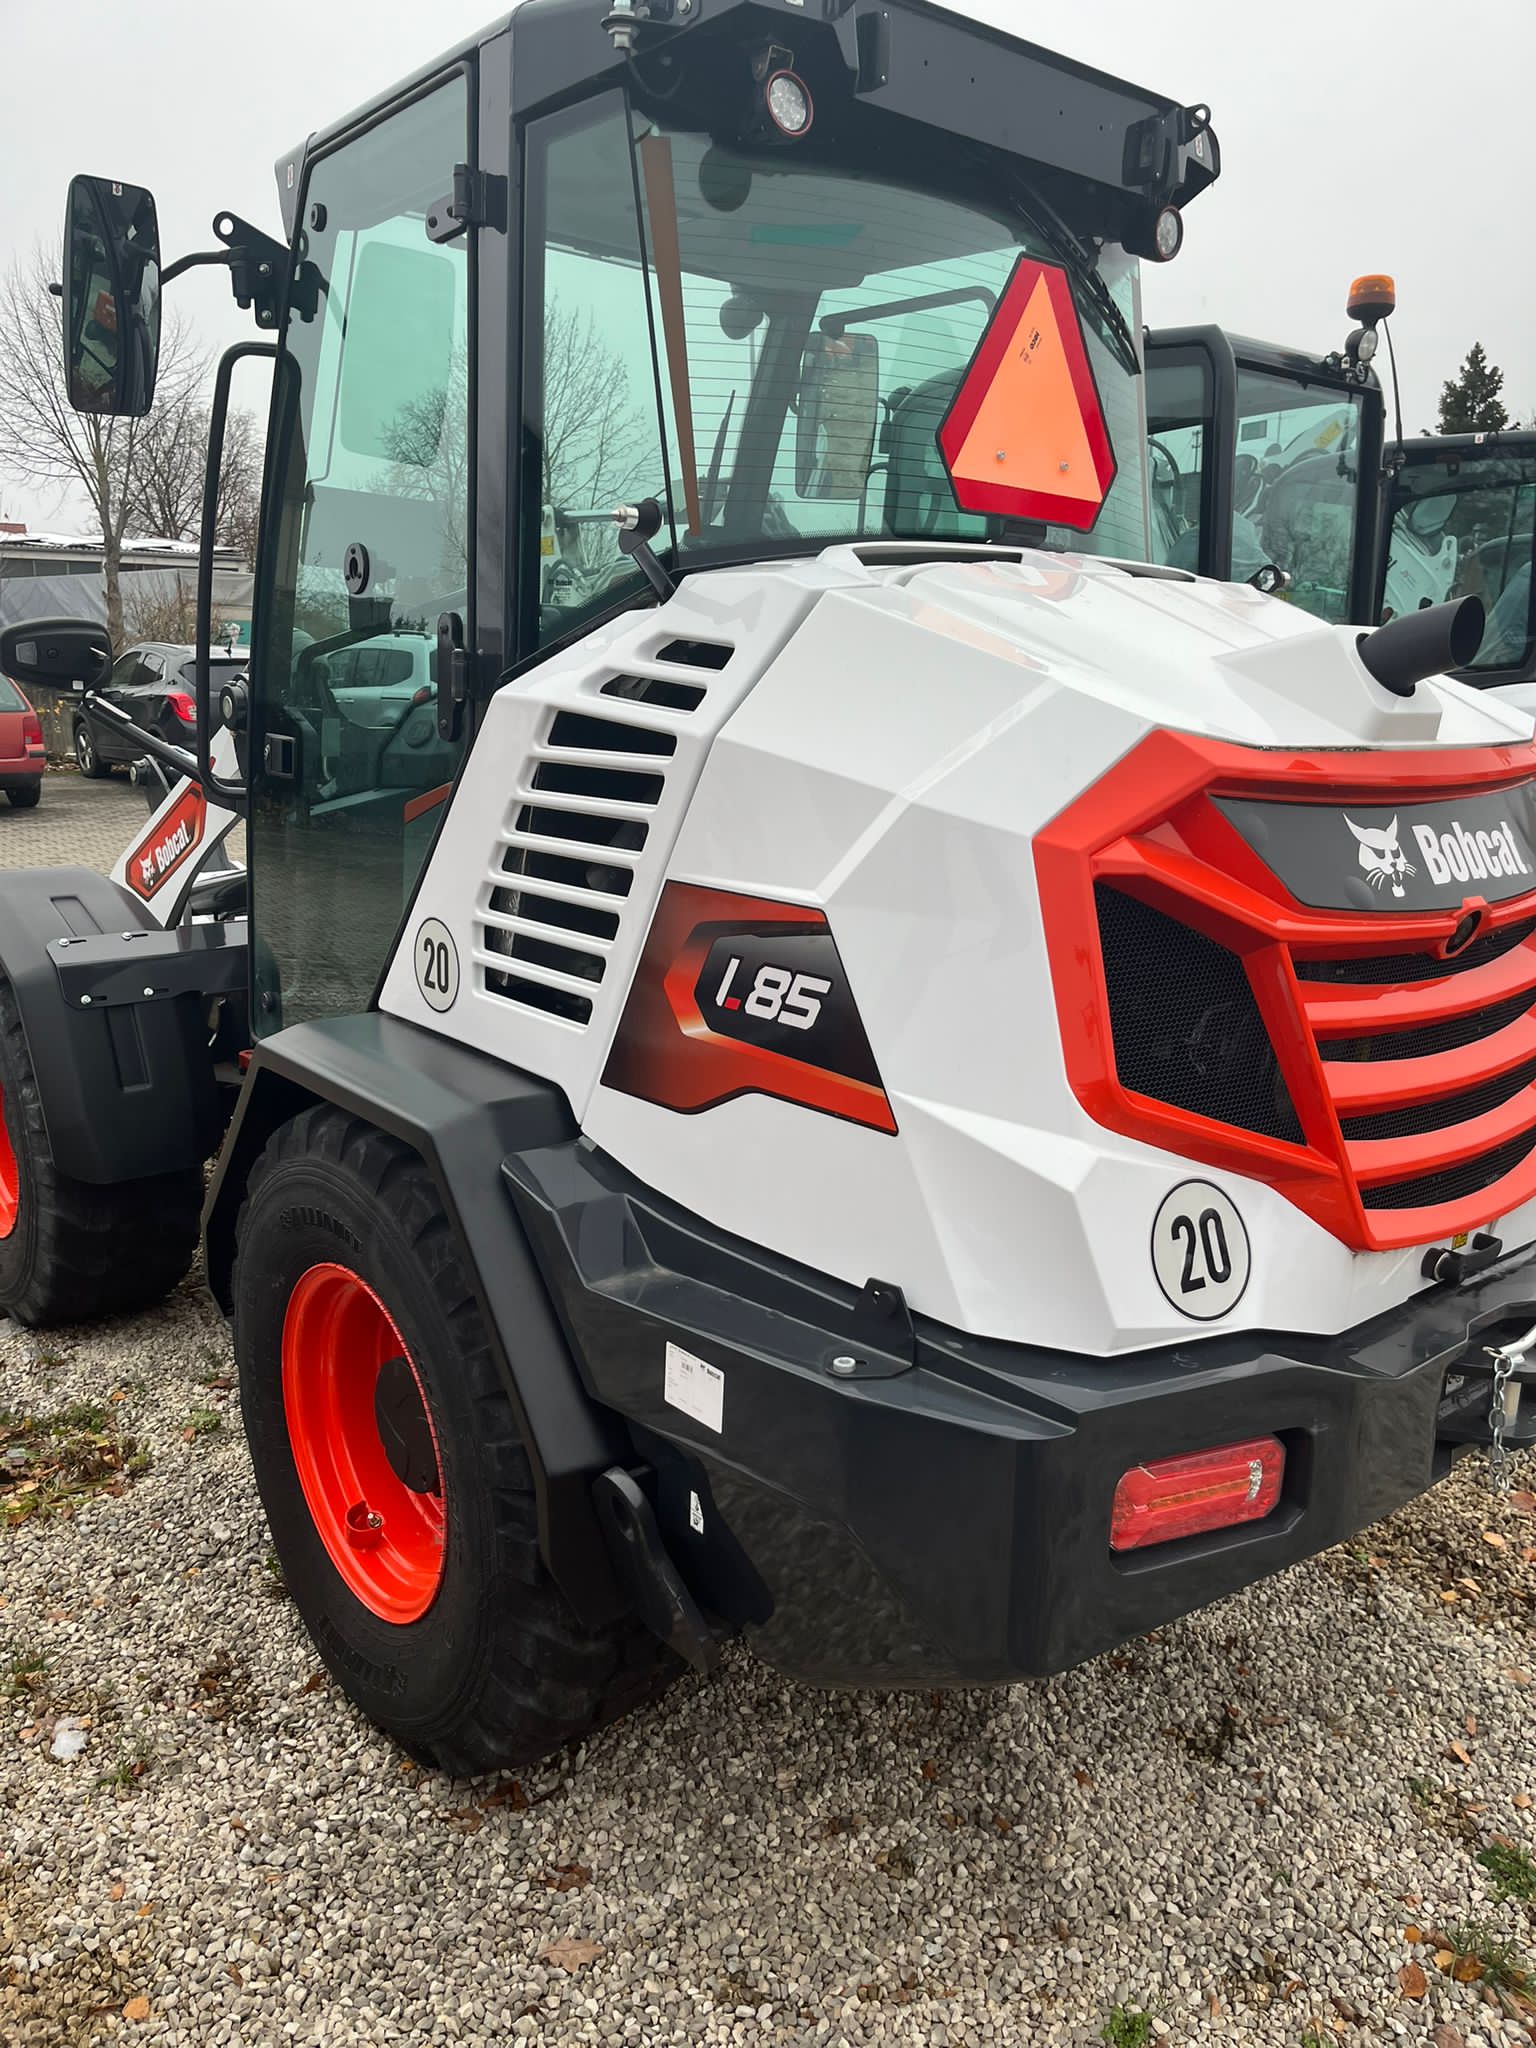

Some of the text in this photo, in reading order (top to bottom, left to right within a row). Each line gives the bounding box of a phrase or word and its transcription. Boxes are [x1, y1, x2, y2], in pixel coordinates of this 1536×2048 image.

[155, 819, 190, 873] Bobcat
[1412, 821, 1528, 885] Bobcat
[424, 937, 449, 994] 20
[1171, 1208, 1232, 1294] 20
